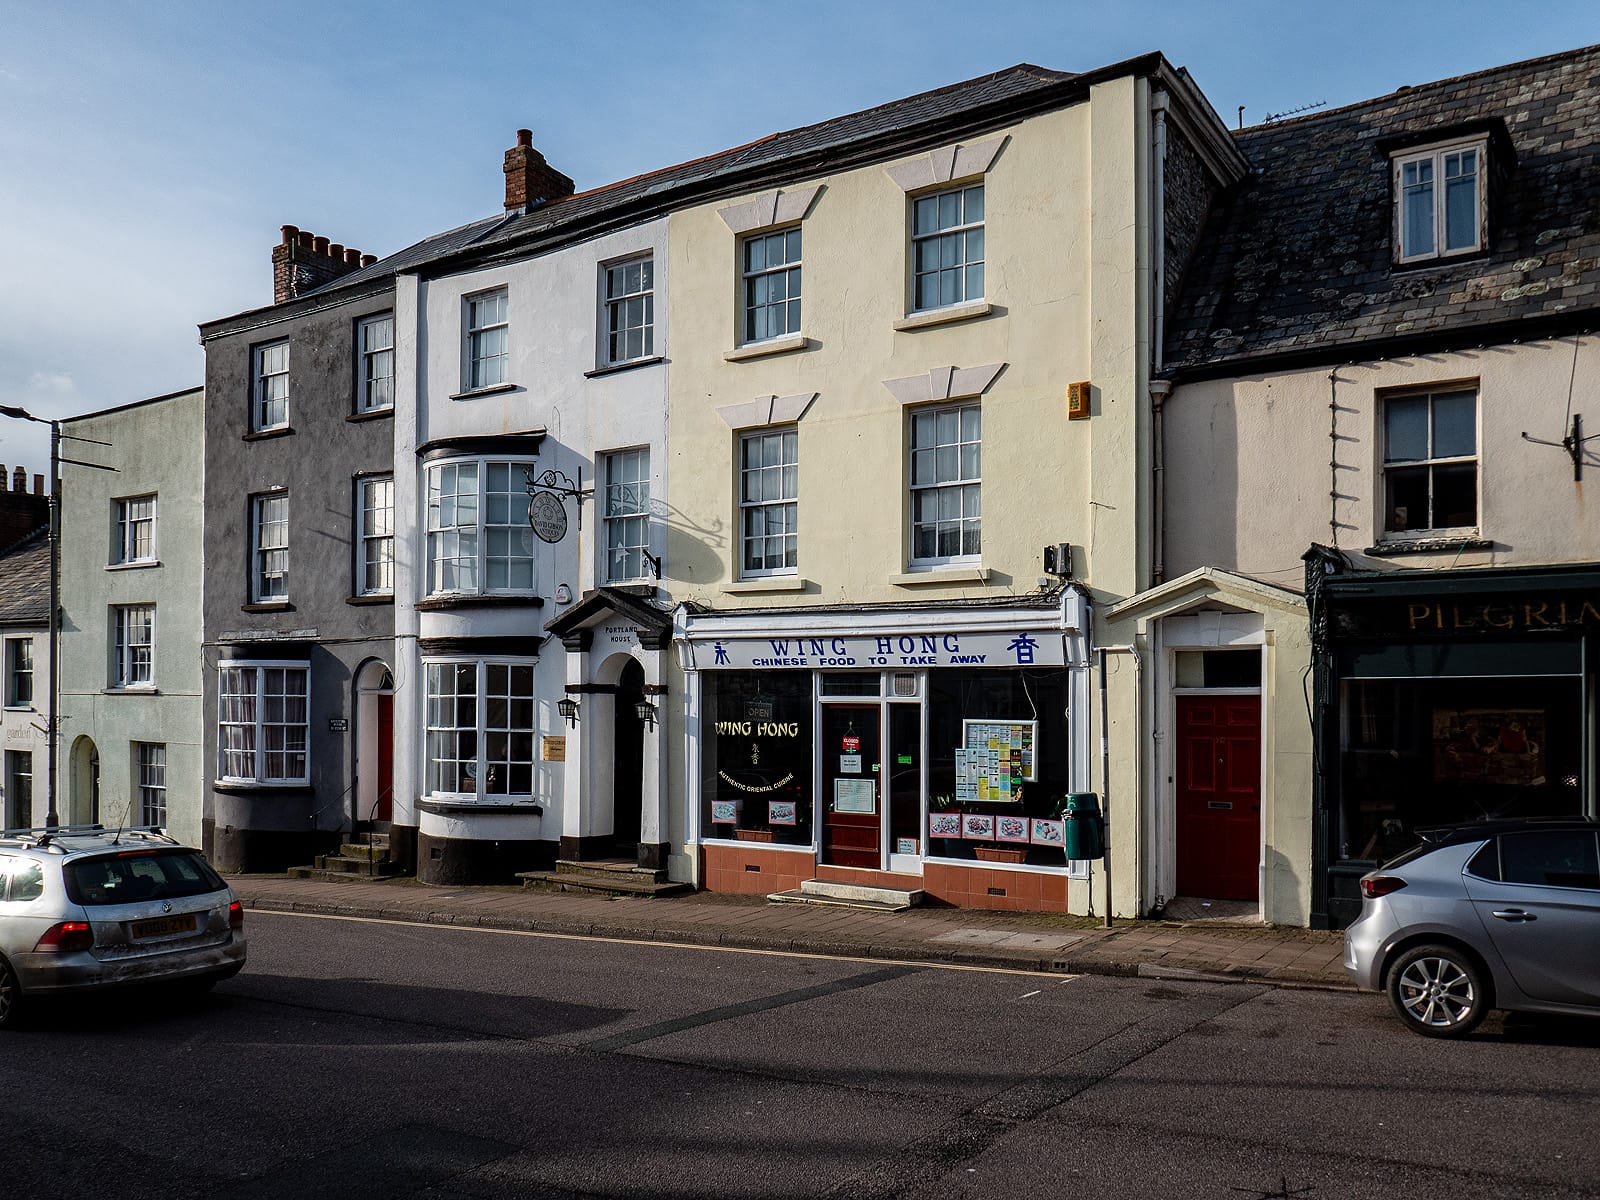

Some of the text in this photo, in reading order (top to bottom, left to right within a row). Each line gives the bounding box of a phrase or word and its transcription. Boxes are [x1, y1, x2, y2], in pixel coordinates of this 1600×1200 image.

[768, 633, 960, 657] WING HONG
[1008, 632, 1039, 664] 香
[751, 654, 987, 667] CHINESE FOOD TO TAKE AWAY
[748, 708, 769, 717] OPEN
[714, 721, 799, 738] WING HONG
[718, 770, 794, 793] AUTHENTIC ORIENTAL CUISINE
